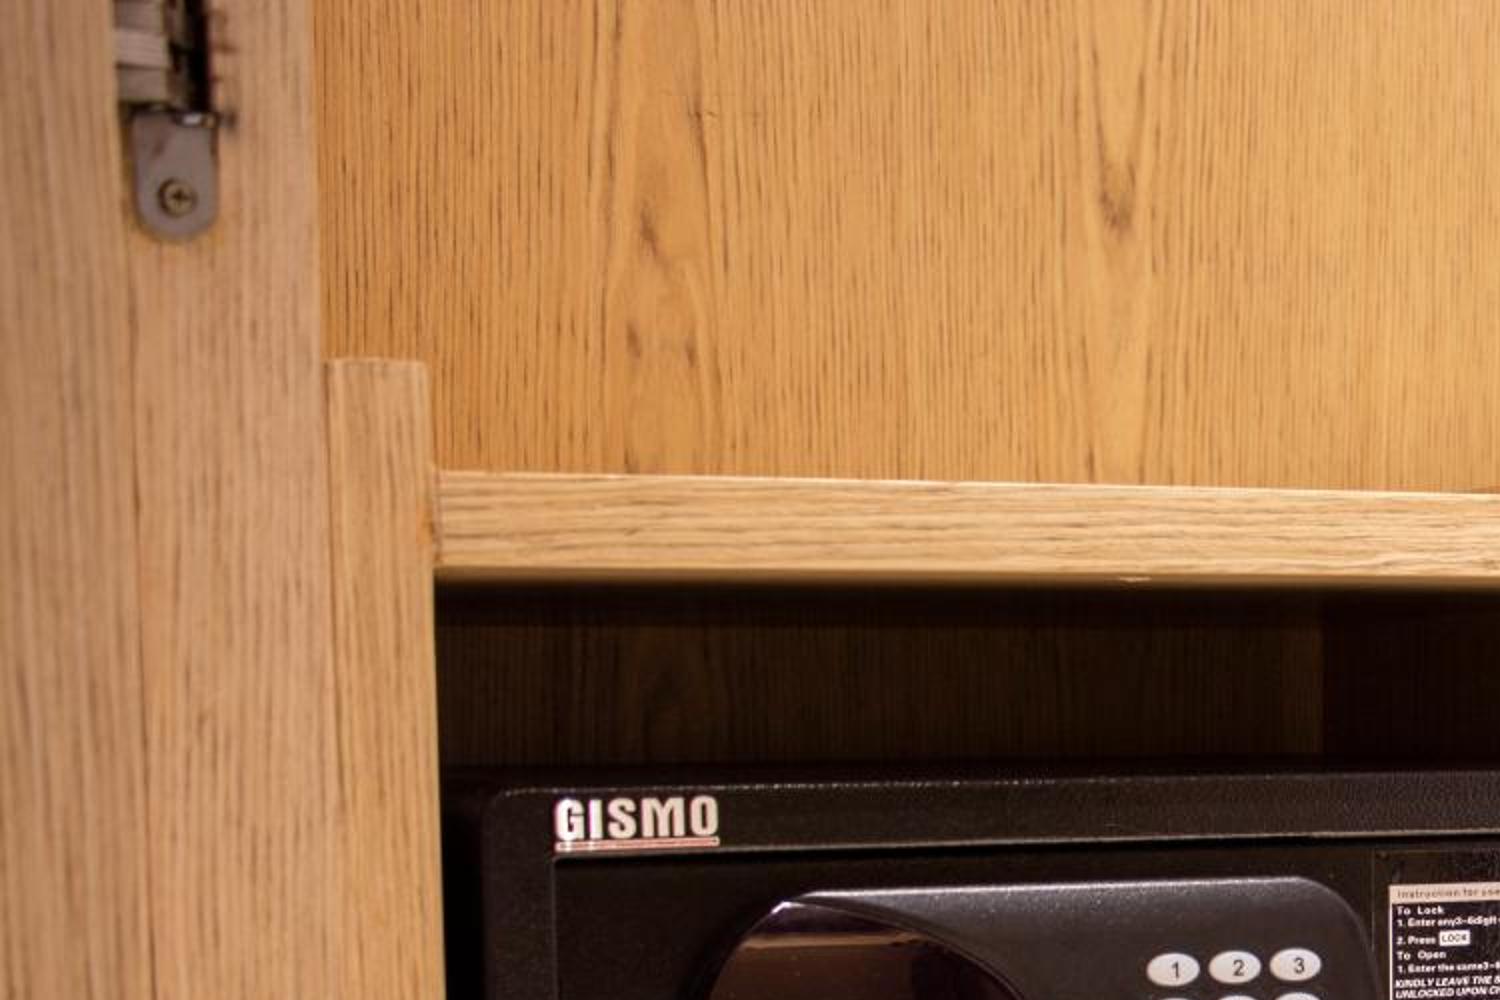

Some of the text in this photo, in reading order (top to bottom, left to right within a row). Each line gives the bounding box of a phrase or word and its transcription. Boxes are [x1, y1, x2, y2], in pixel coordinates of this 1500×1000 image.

[556, 796, 719, 841] GISMO
[1397, 905, 1445, 915] To Lock
[1397, 919, 1406, 927] 1.
[1407, 918, 1436, 927] Enter
[1396, 933, 1467, 945] 2. Press LOCK
[1397, 951, 1447, 961] To Open
[1172, 957, 1305, 979] 1 2 3
[1397, 966, 1406, 974] 1.
[1407, 965, 1436, 973] Enter
[1437, 964, 1456, 972] the
[1395, 978, 1435, 989] KINDLY
[1435, 977, 1470, 987] LEAVE
[1472, 976, 1492, 985] THE
[1395, 988, 1455, 999] UNLOCKED
[1455, 987, 1487, 996] UPON
